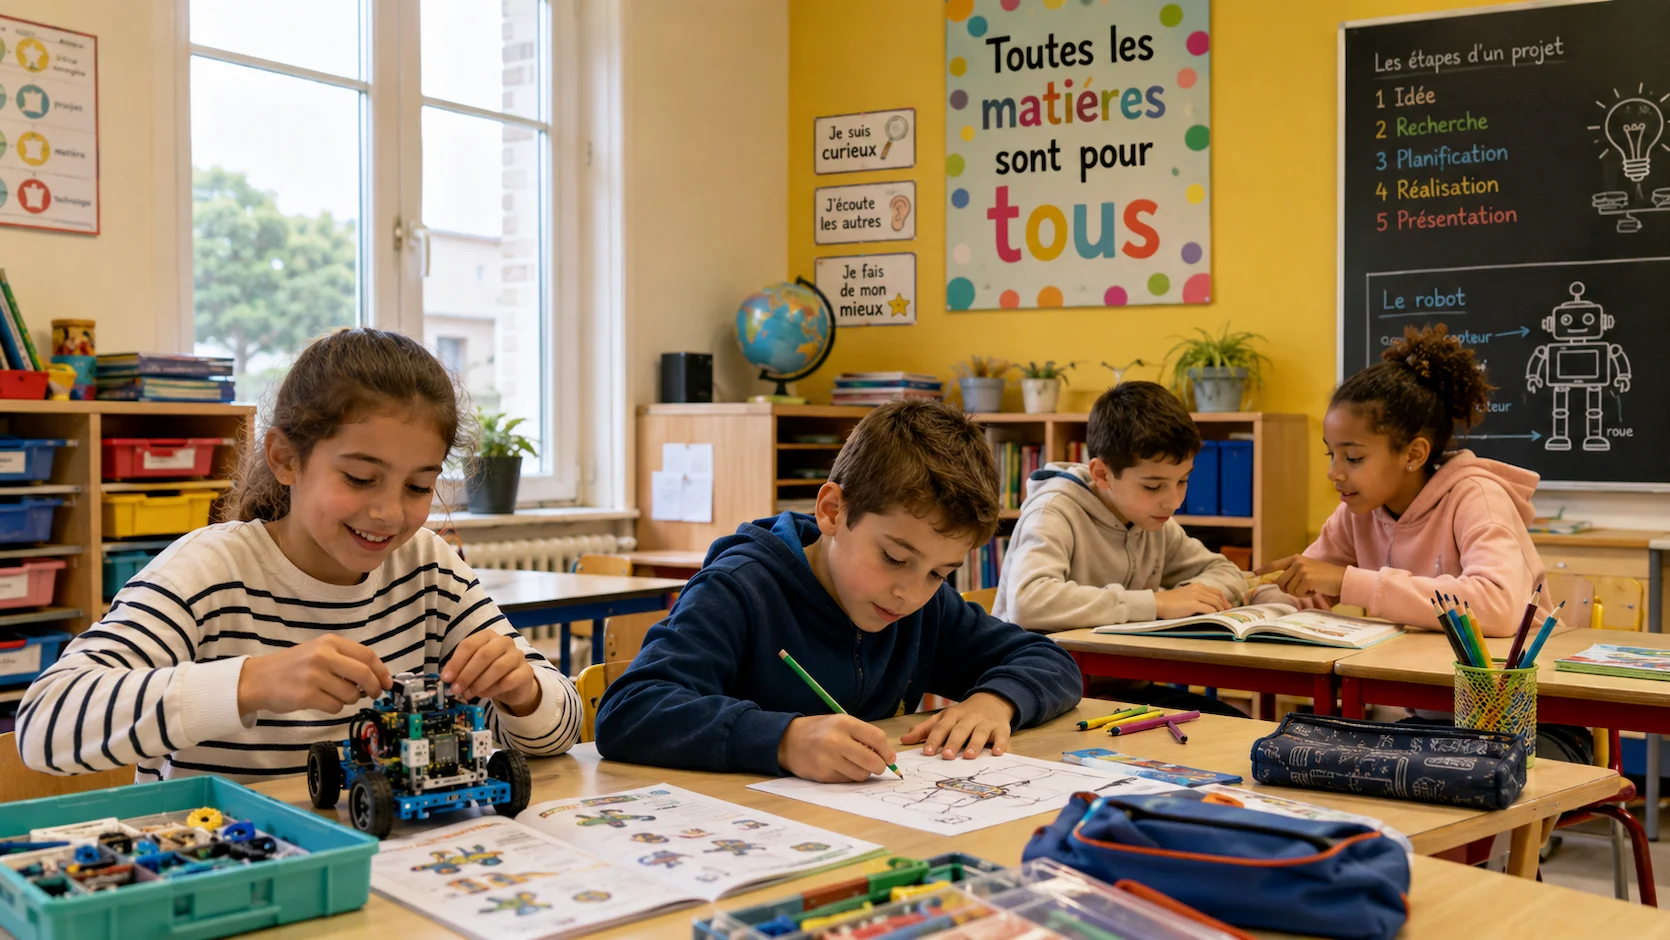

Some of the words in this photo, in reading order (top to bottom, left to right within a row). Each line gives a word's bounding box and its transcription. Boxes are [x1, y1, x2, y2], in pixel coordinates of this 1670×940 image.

[985, 33, 1094, 74] Toutes
[1110, 25, 1154, 63] les
[1374, 53, 1402, 73] Les
[1408, 49, 1461, 74] étapes
[1467, 43, 1504, 63] d'un
[1511, 36, 1565, 67] projet
[1375, 90, 1386, 109] 1
[1394, 85, 1437, 108] Idée
[828, 125, 844, 141] Je
[847, 124, 872, 139] suis
[1375, 120, 1388, 140] 2
[1396, 111, 1490, 138] Recherche
[821, 143, 878, 161] curieux
[995, 139, 1062, 175] sont
[1080, 142, 1154, 183] pour
[1375, 152, 1388, 171] 3
[1396, 144, 1509, 172] Planification
[1375, 182, 1388, 201] 4
[1397, 176, 1500, 200] Réalisation
[825, 196, 876, 213] J'écoute
[820, 216, 838, 231] les
[842, 214, 882, 230] autres
[986, 185, 1161, 264] tous
[1376, 212, 1388, 232] 5
[1397, 205, 1518, 231] Présentation
[842, 264, 857, 280] Je
[861, 263, 885, 279] fais
[840, 282, 856, 298] de
[859, 284, 887, 297] mon
[1383, 289, 1405, 310] Le
[1415, 286, 1466, 308] robot
[839, 302, 884, 318] mieux
[1606, 427, 1634, 438] roue
